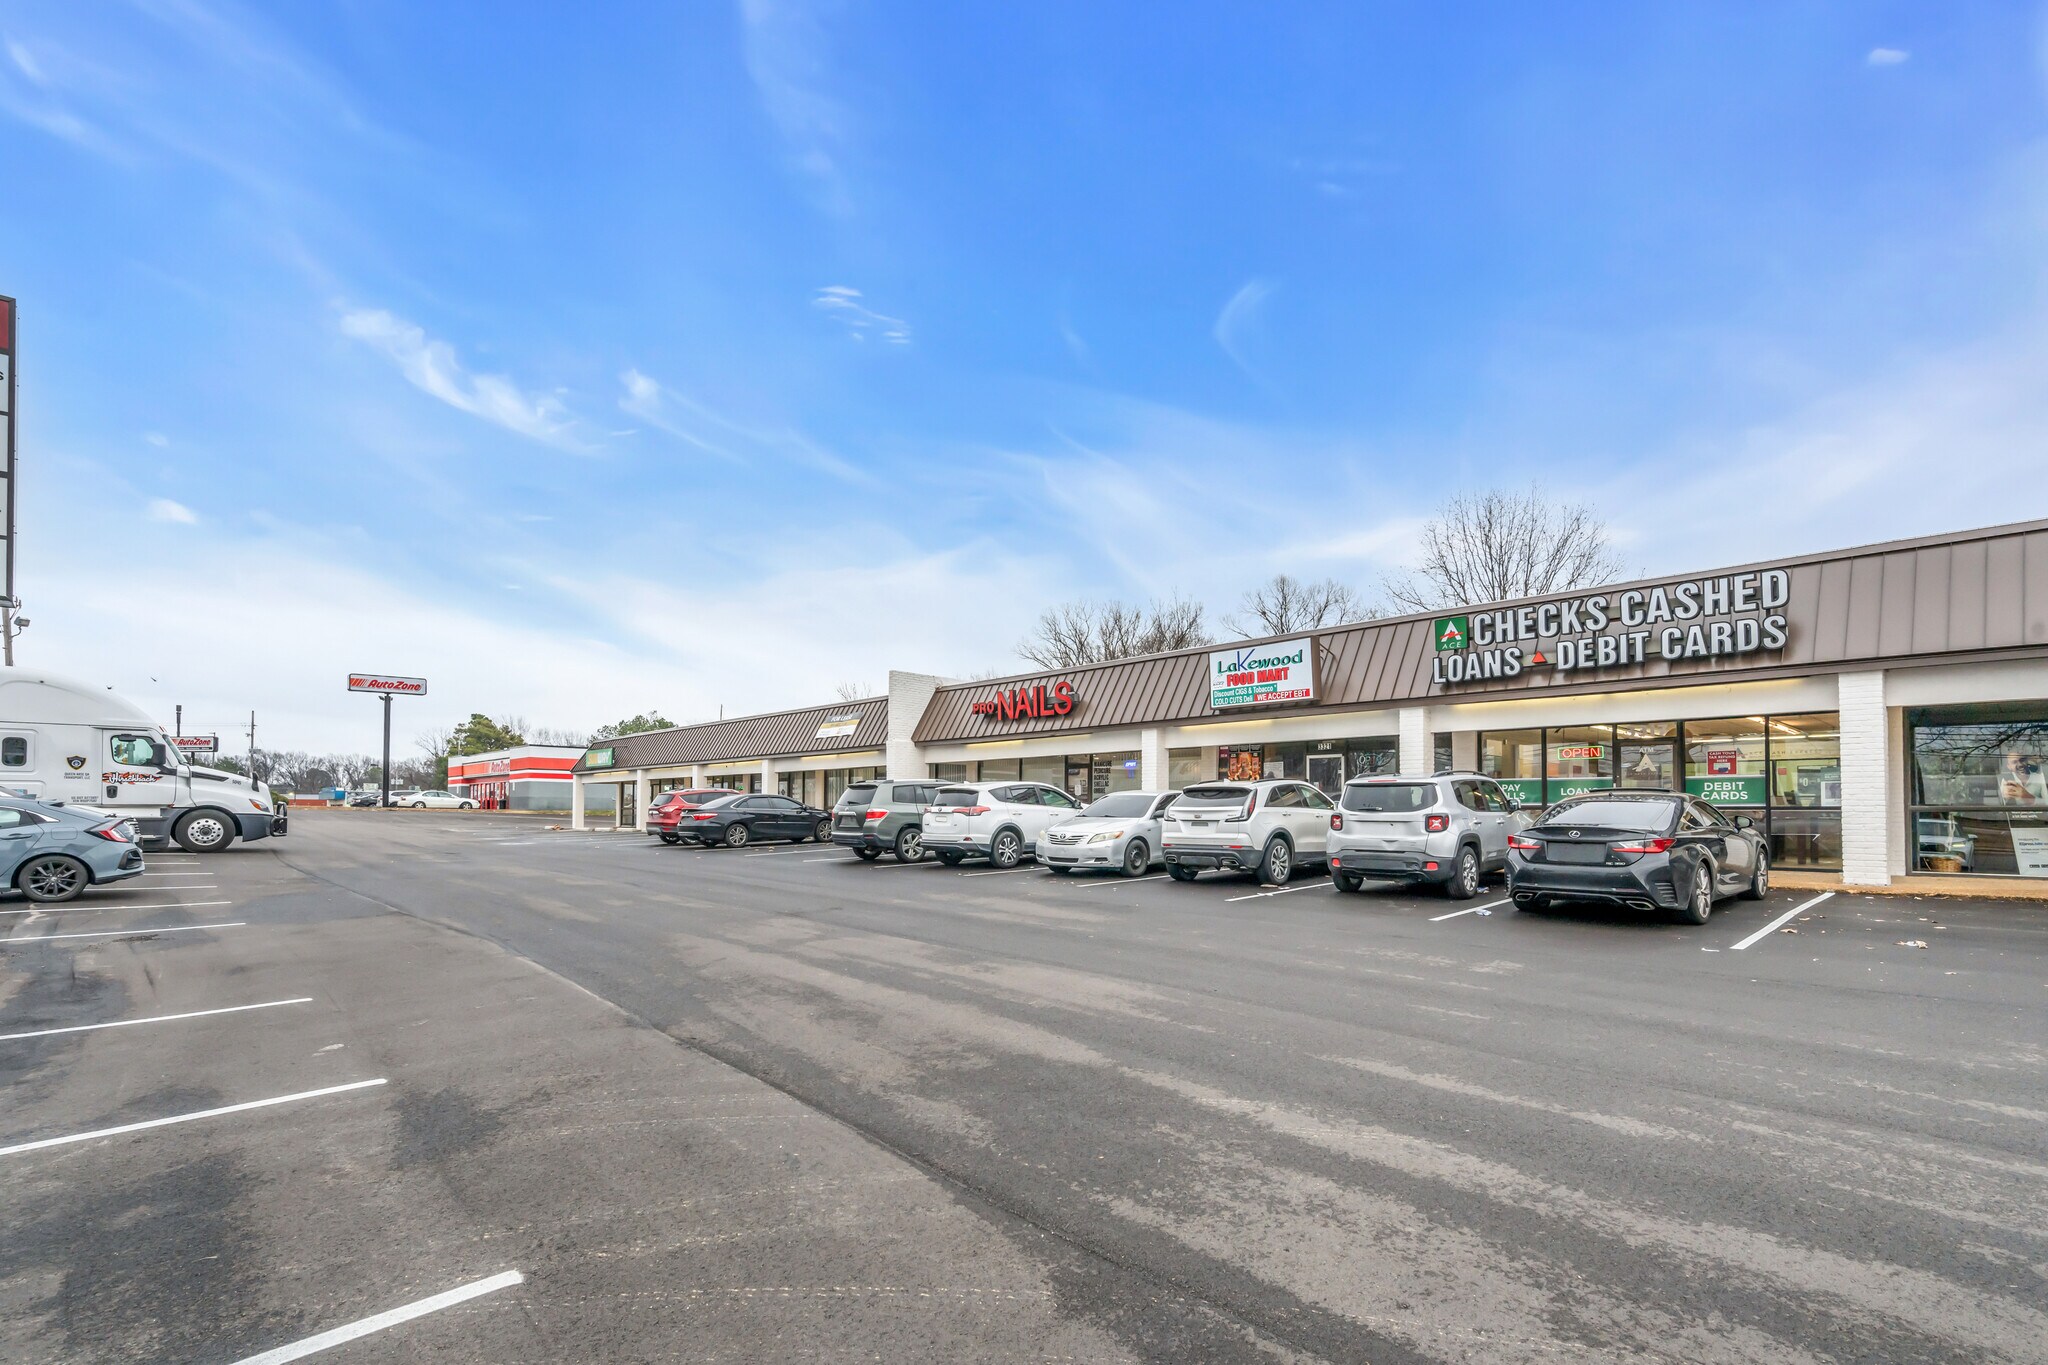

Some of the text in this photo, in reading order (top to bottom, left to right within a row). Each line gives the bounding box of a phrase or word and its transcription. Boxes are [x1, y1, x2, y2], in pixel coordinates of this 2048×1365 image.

[1473, 569, 1790, 646] CHECKS CASHED
[1432, 615, 1788, 685] LOANS DEBIT CARDS
[1442, 641, 1461, 650] ACE
[1226, 671, 1255, 687] FOOD
[1257, 667, 1289, 683] MART
[367, 679, 422, 691] AutoZone
[1214, 685, 1273, 698] Discount CIGS & Tobacco
[1267, 691, 1292, 700] ACCEPT
[1294, 689, 1307, 697] EBT
[972, 681, 1073, 721] PRO NAILS
[1214, 695, 1253, 706] COLD CUTS Deli
[178, 737, 211, 746] AutoZone
[1562, 747, 1601, 759] OPEN
[1502, 784, 1521, 792] PAY
[1704, 781, 1745, 791] DEBIT
[1701, 791, 1748, 800] CARDS
